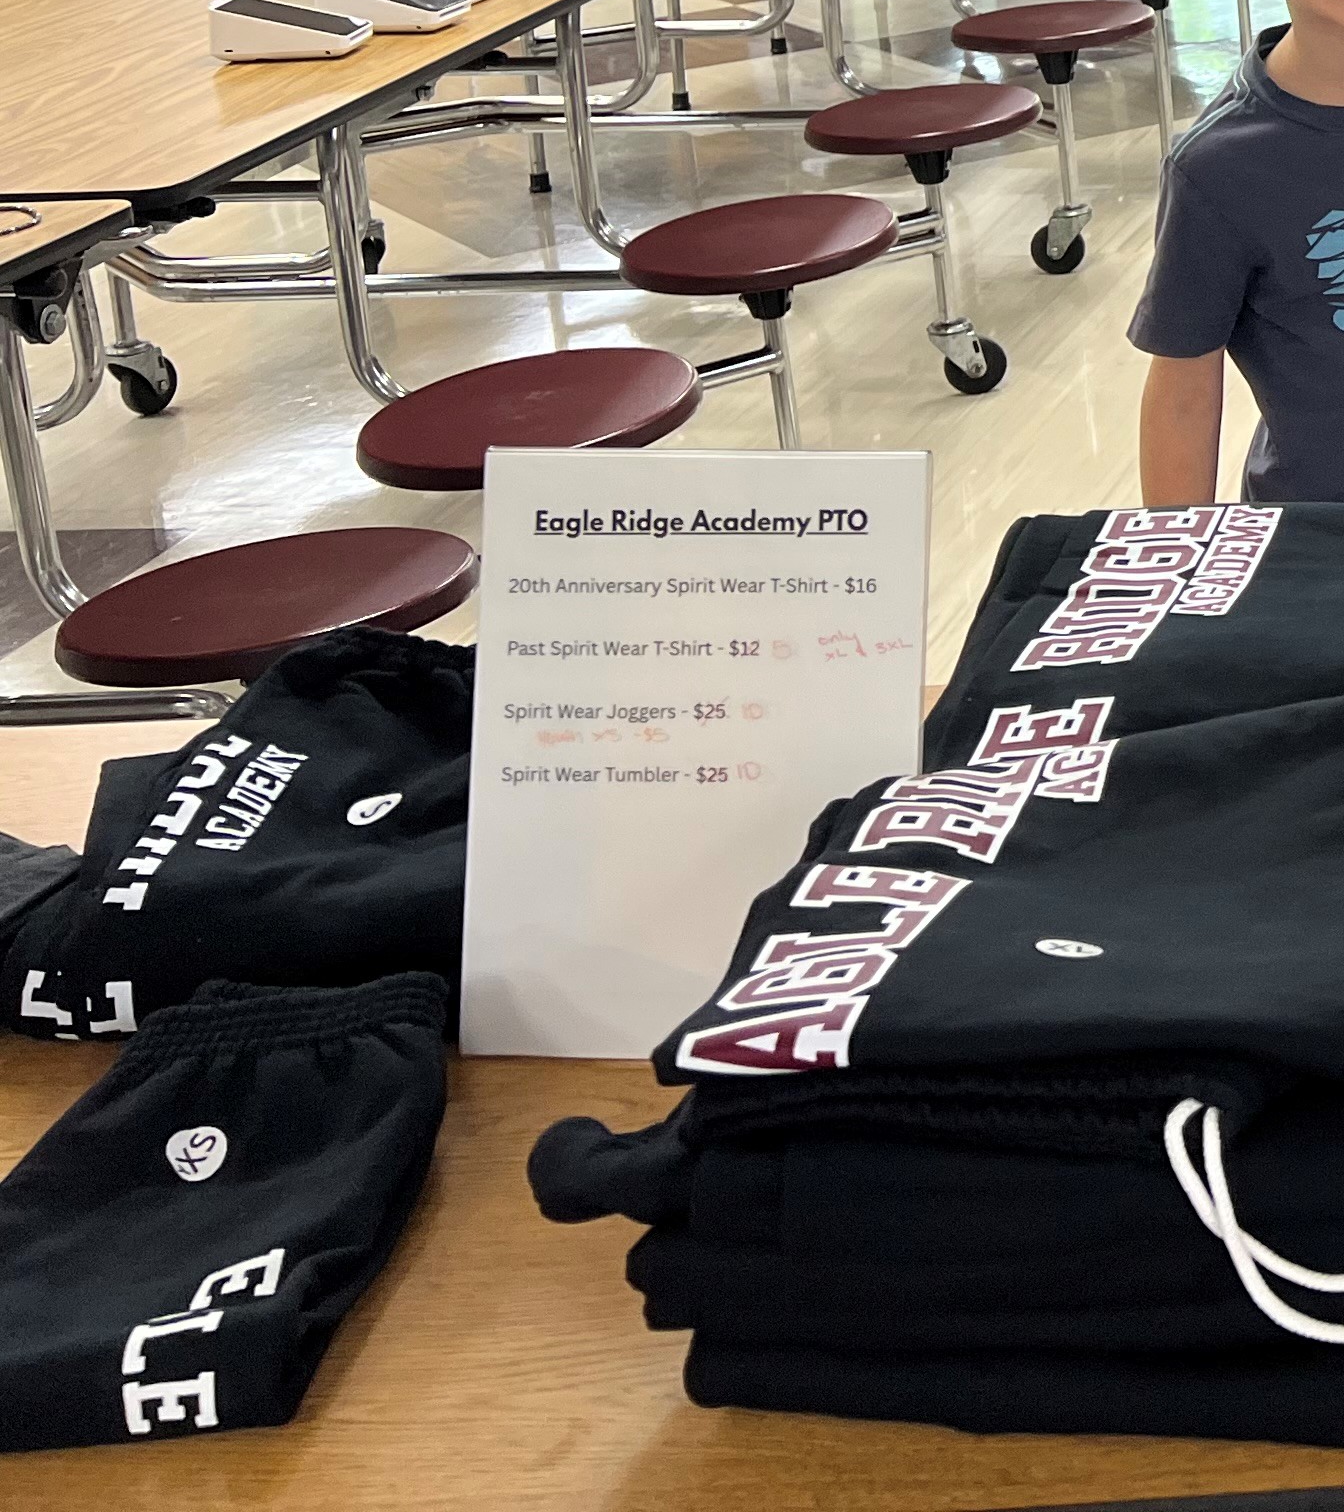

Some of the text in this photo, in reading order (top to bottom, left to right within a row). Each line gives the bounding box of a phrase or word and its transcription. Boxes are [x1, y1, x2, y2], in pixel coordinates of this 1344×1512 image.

[535, 509, 869, 538] Eagle Ridge Academy PTO
[1170, 505, 1284, 616] ACADEMY
[509, 578, 550, 594] 20th
[555, 578, 662, 597] Anniversary
[667, 578, 716, 597] Spirit
[720, 578, 766, 594] Wear
[770, 577, 829, 594] T-Shirt
[844, 576, 877, 595] $16
[1010, 505, 1224, 673] RIDGE
[507, 640, 545, 657] Past
[550, 640, 599, 660] Spirit
[603, 640, 648, 657] Wear
[653, 639, 714, 657] T-Shirt
[728, 639, 760, 658] $12
[504, 703, 552, 723] Spirit
[557, 703, 601, 719] Wear
[606, 703, 676, 723] Joggers
[693, 702, 726, 721] $25
[501, 766, 551, 786] Spirit
[555, 766, 601, 783] Wear
[606, 766, 680, 783] Tumbler
[696, 766, 729, 784] $25
[737, 761, 762, 781] 10
[196, 744, 309, 852] ACADEMY
[675, 862, 974, 1074] AGLE
